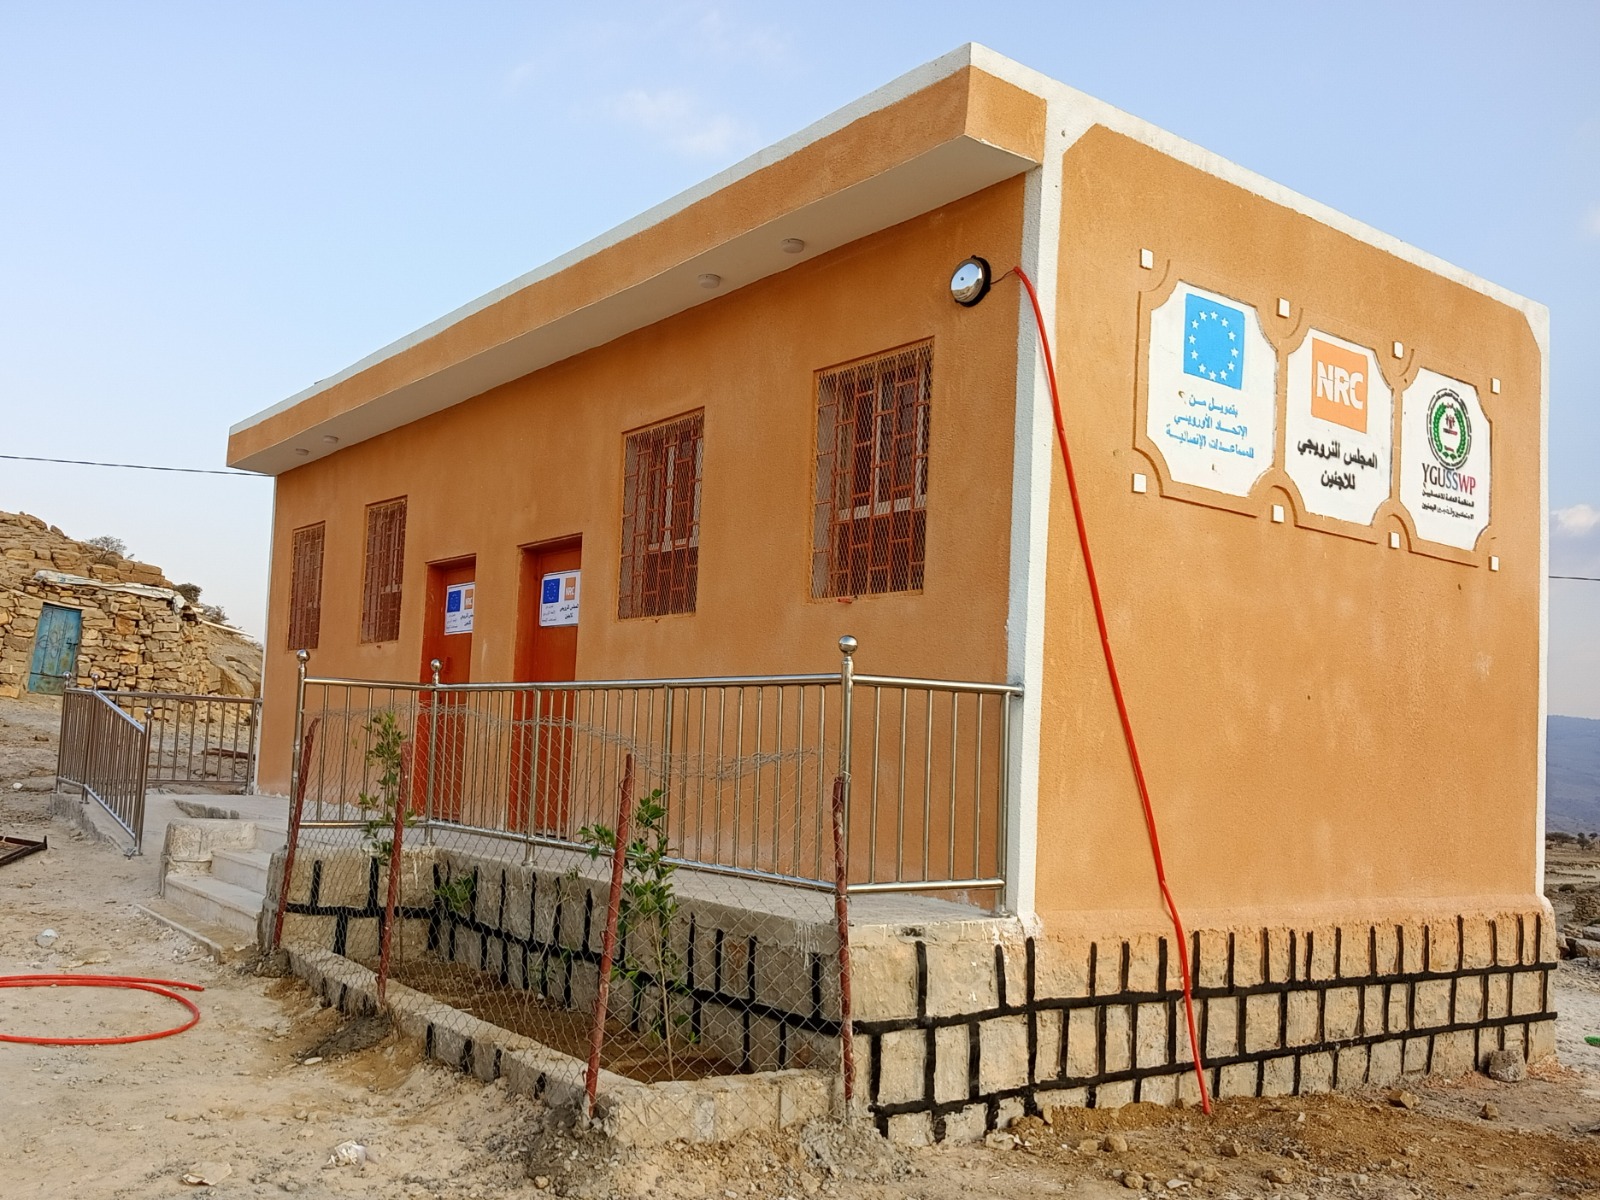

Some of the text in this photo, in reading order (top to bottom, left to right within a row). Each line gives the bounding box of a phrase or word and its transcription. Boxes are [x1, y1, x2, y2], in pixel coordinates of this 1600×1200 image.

[1316, 360, 1364, 410] NRC
[1188, 394, 1239, 418] بتمويل من
[1297, 438, 1378, 470] المجلس النرويجي
[1421, 463, 1476, 496] YGUSSWP
